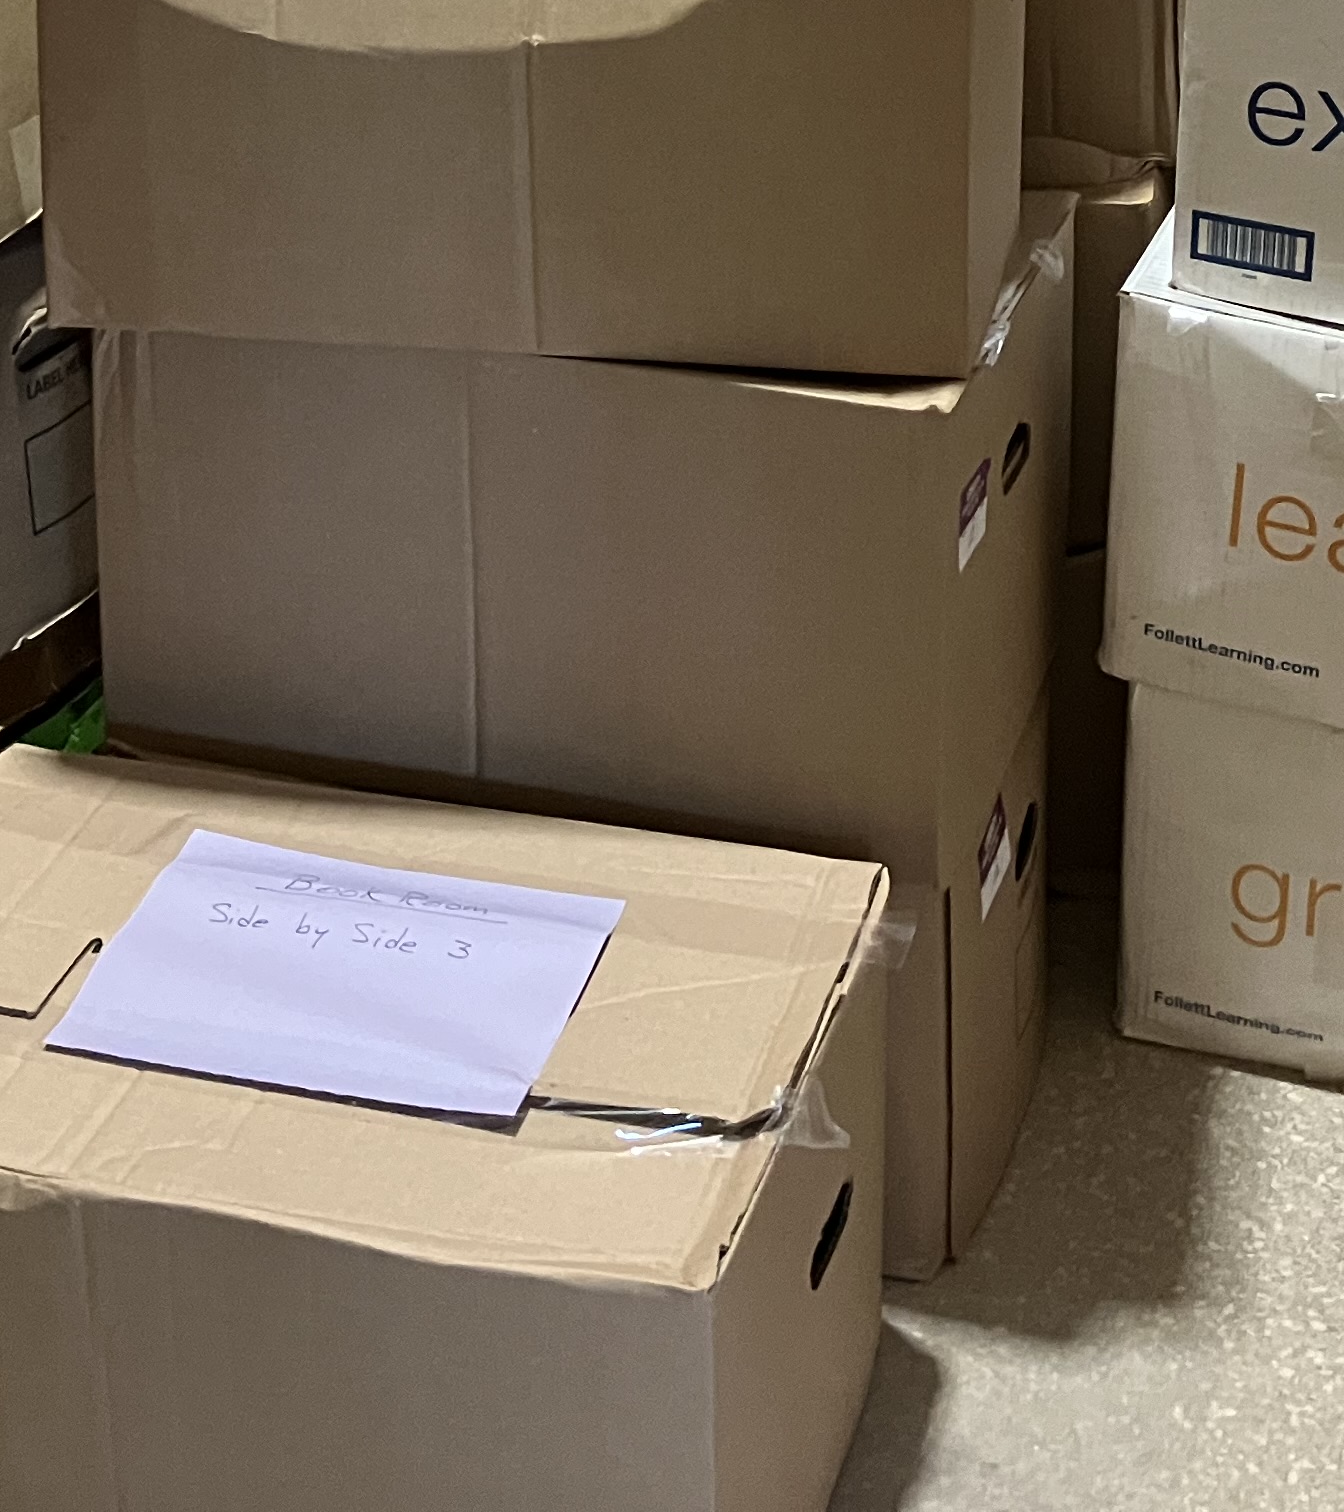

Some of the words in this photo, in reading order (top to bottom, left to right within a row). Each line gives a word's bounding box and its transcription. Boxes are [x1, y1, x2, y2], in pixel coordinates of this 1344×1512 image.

[1143, 622, 1321, 679] FollettLearning.com
[284, 873, 379, 902] Book
[399, 890, 489, 916] Room
[208, 902, 270, 930] Side
[295, 913, 331, 949] by
[351, 923, 418, 954] Side
[447, 939, 473, 960] 3
[1153, 989, 1325, 1043] FollettLearning.com
